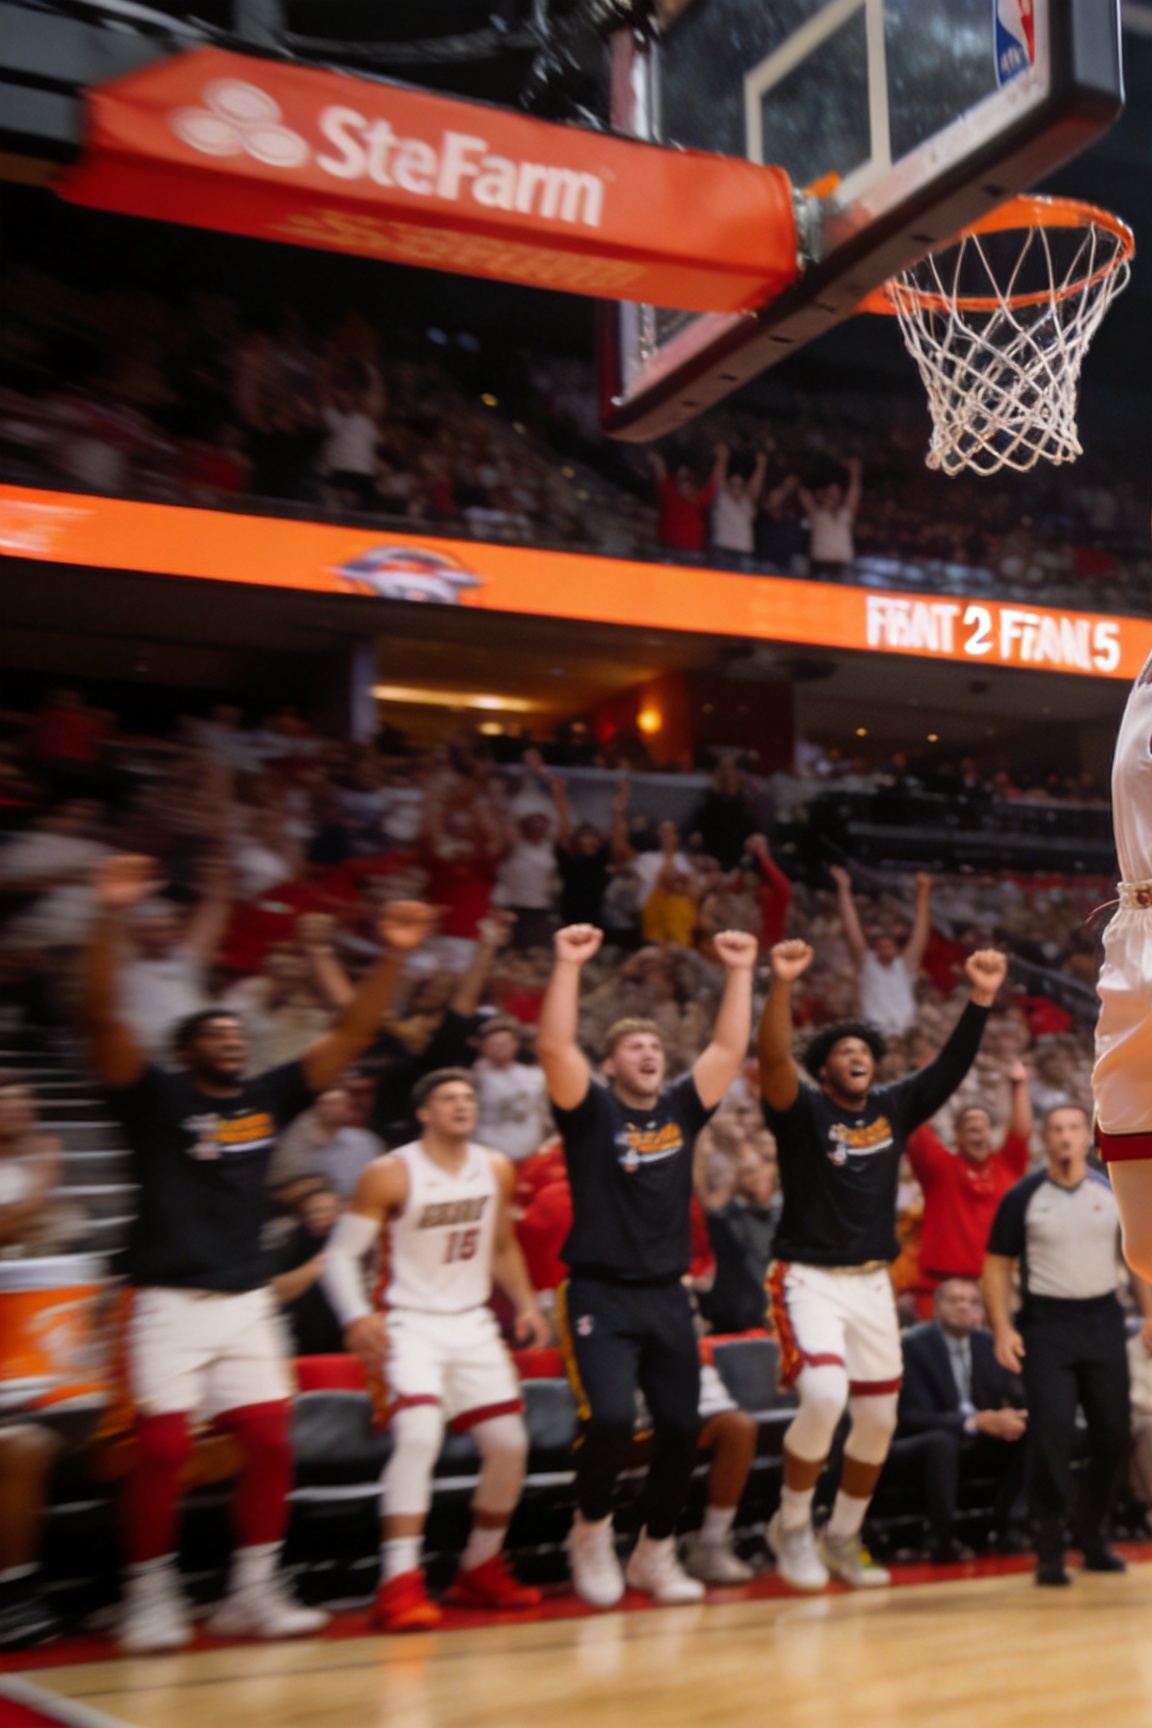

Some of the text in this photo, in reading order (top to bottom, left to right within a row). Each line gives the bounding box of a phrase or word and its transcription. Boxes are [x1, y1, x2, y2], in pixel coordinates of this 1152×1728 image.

[315, 104, 605, 228] SteFarm
[963, 605, 993, 655] 2
[443, 1228, 481, 1264] 15
